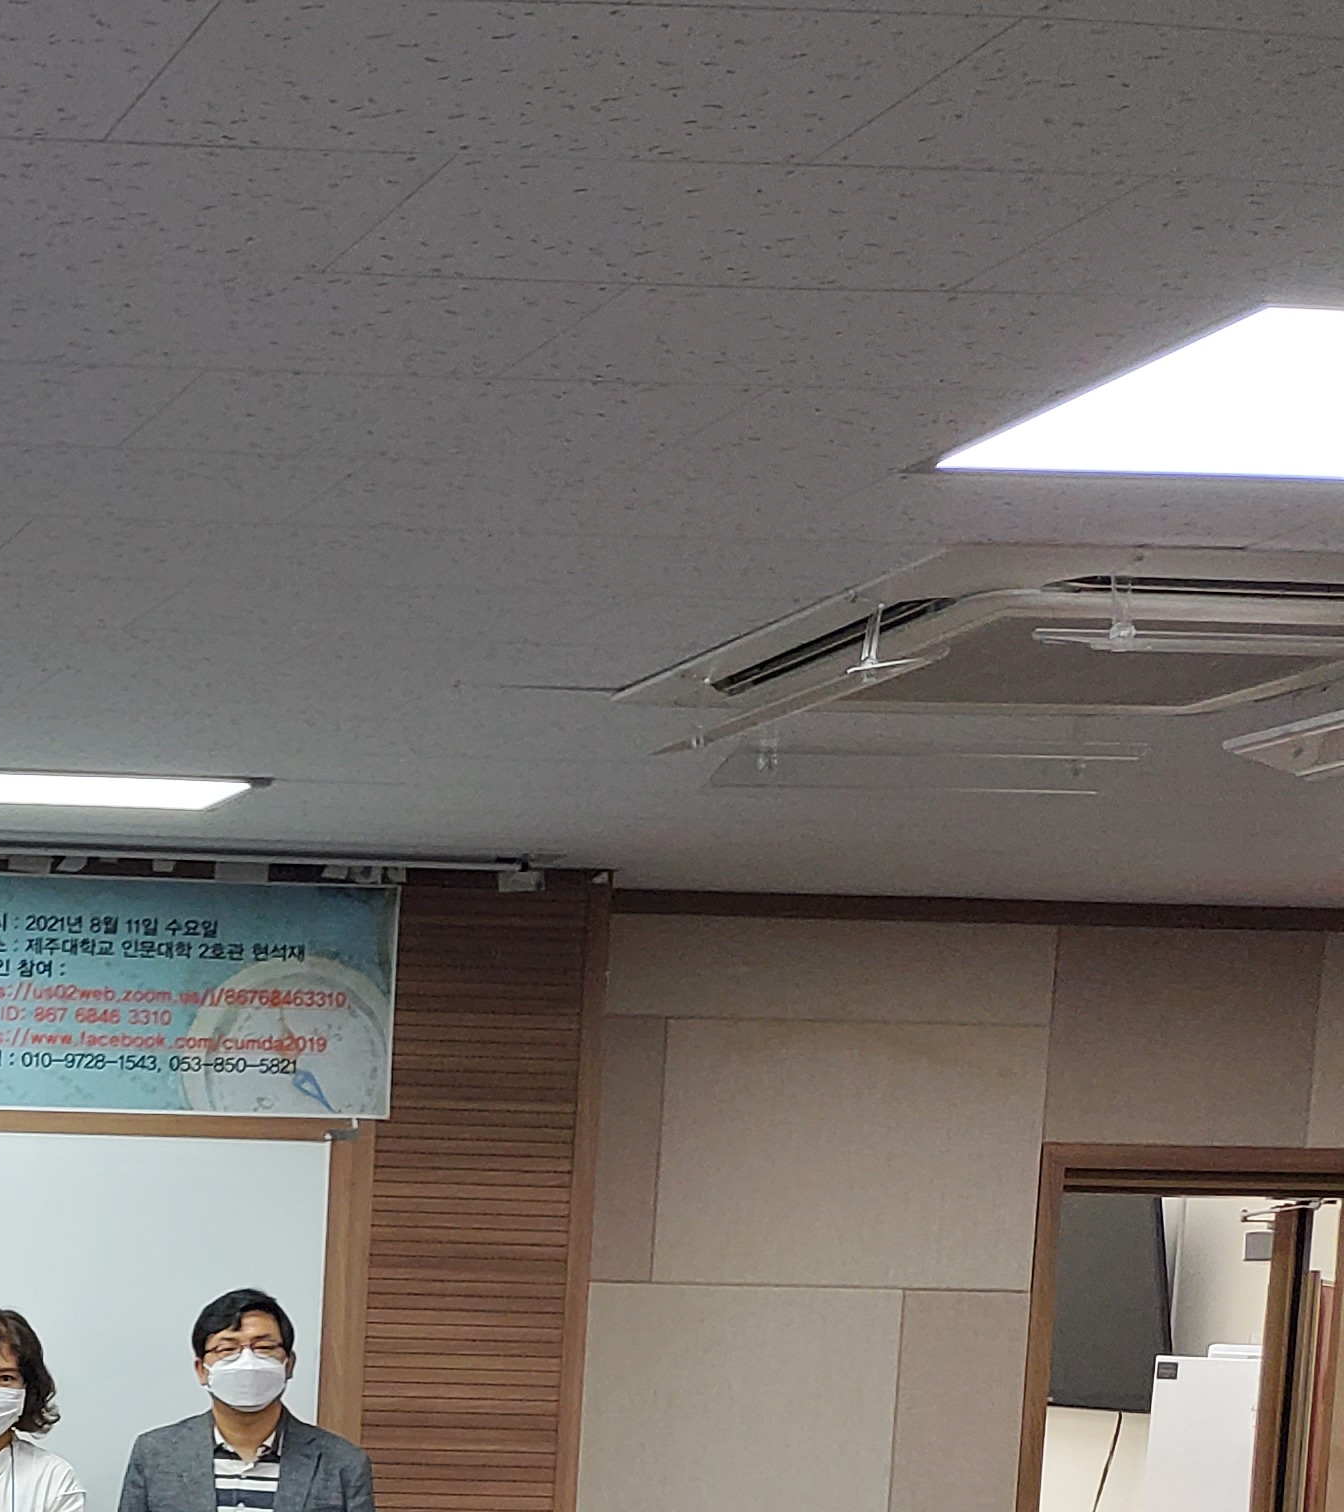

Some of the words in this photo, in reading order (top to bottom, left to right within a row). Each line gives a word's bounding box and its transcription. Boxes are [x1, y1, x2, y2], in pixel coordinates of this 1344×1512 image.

[24, 914, 83, 934] 2021년
[89, 915, 119, 935] 8월
[125, 917, 158, 937] 11일
[165, 918, 219, 938] 수요일
[24, 936, 115, 957] 제주대학교
[121, 939, 192, 959] 인문대학
[198, 942, 245, 961] 2호관
[252, 943, 306, 962] 현석재
[17, 958, 53, 978] 참여
[0, 1005, 26, 1021] ID:
[33, 1006, 69, 1023] 867
[74, 1008, 121, 1024] 6846
[128, 1009, 172, 1026] 3310
[169, 1056, 297, 1074] 053-850-5821
